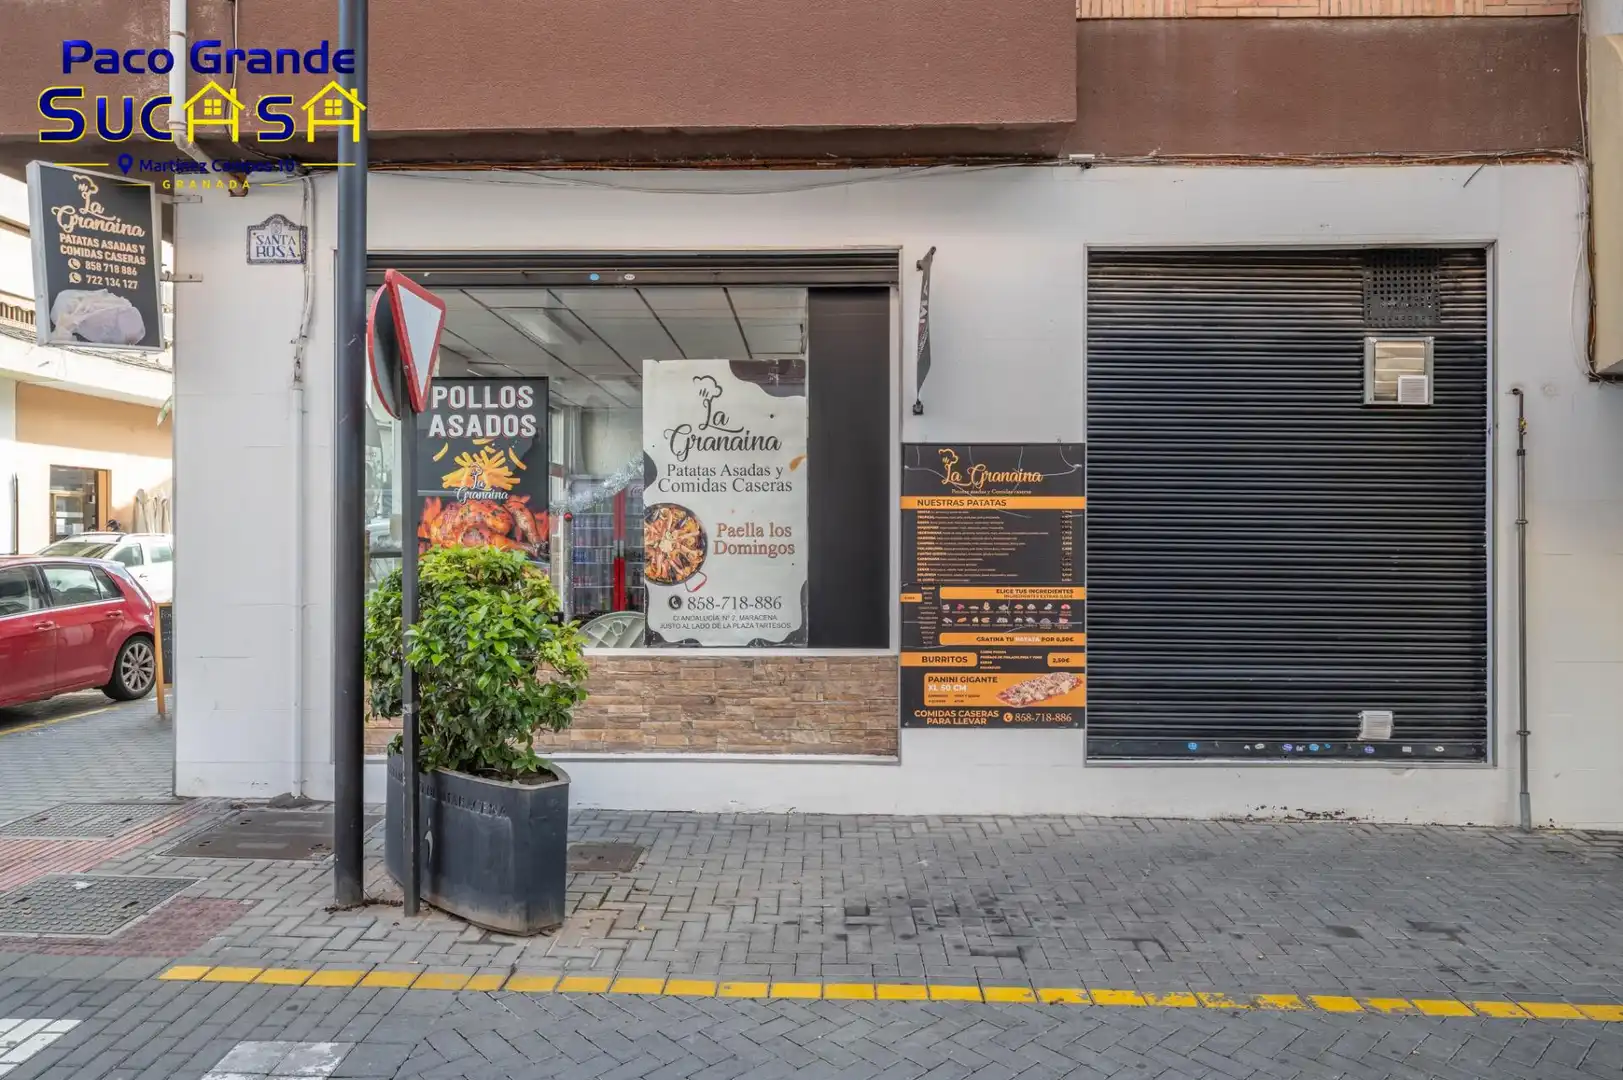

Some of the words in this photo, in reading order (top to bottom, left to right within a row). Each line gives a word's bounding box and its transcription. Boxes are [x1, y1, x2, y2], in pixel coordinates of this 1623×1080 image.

[79, 191, 116, 220] La
[59, 233, 100, 248] PATATAS
[101, 240, 138, 253] ASADAS
[139, 245, 146, 254] Y
[256, 235, 297, 246] SANTA
[60, 245, 103, 260] COMIDAS
[104, 252, 146, 265] CASERAS
[256, 246, 297, 258] ROSA
[85, 261, 102, 272] 858
[103, 263, 119, 274] 718
[121, 265, 138, 276] 886
[86, 275, 102, 285] 722
[105, 278, 121, 288] 134
[123, 280, 138, 290] 127
[431, 386, 535, 409] POLLOS
[698, 399, 744, 433] La
[428, 414, 537, 438] ASADOS
[663, 424, 782, 462] Granaina
[667, 464, 717, 477] Patatas
[720, 464, 771, 477] Asadas
[775, 466, 784, 479] y
[941, 463, 972, 487] La
[967, 463, 1044, 489] Granaina
[658, 478, 727, 493] Comidas
[732, 478, 793, 493] Caseras
[917, 499, 964, 507] NUESTRAS
[966, 499, 1007, 507] PATATAS
[716, 522, 764, 538] Paella
[769, 522, 792, 538] los
[713, 539, 796, 559] Domingos
[687, 596, 782, 611] 858-718-886
[682, 622, 690, 630] AL
[921, 655, 968, 664] BURRITOS
[928, 676, 960, 684] PANINI
[960, 676, 998, 684] GIGANTE
[914, 710, 957, 718] COMIDAS
[958, 710, 999, 718] CASERAS
[1014, 713, 1072, 722] 858-718-886
[927, 718, 951, 726] PARA
[953, 718, 987, 726] LLEVAR
